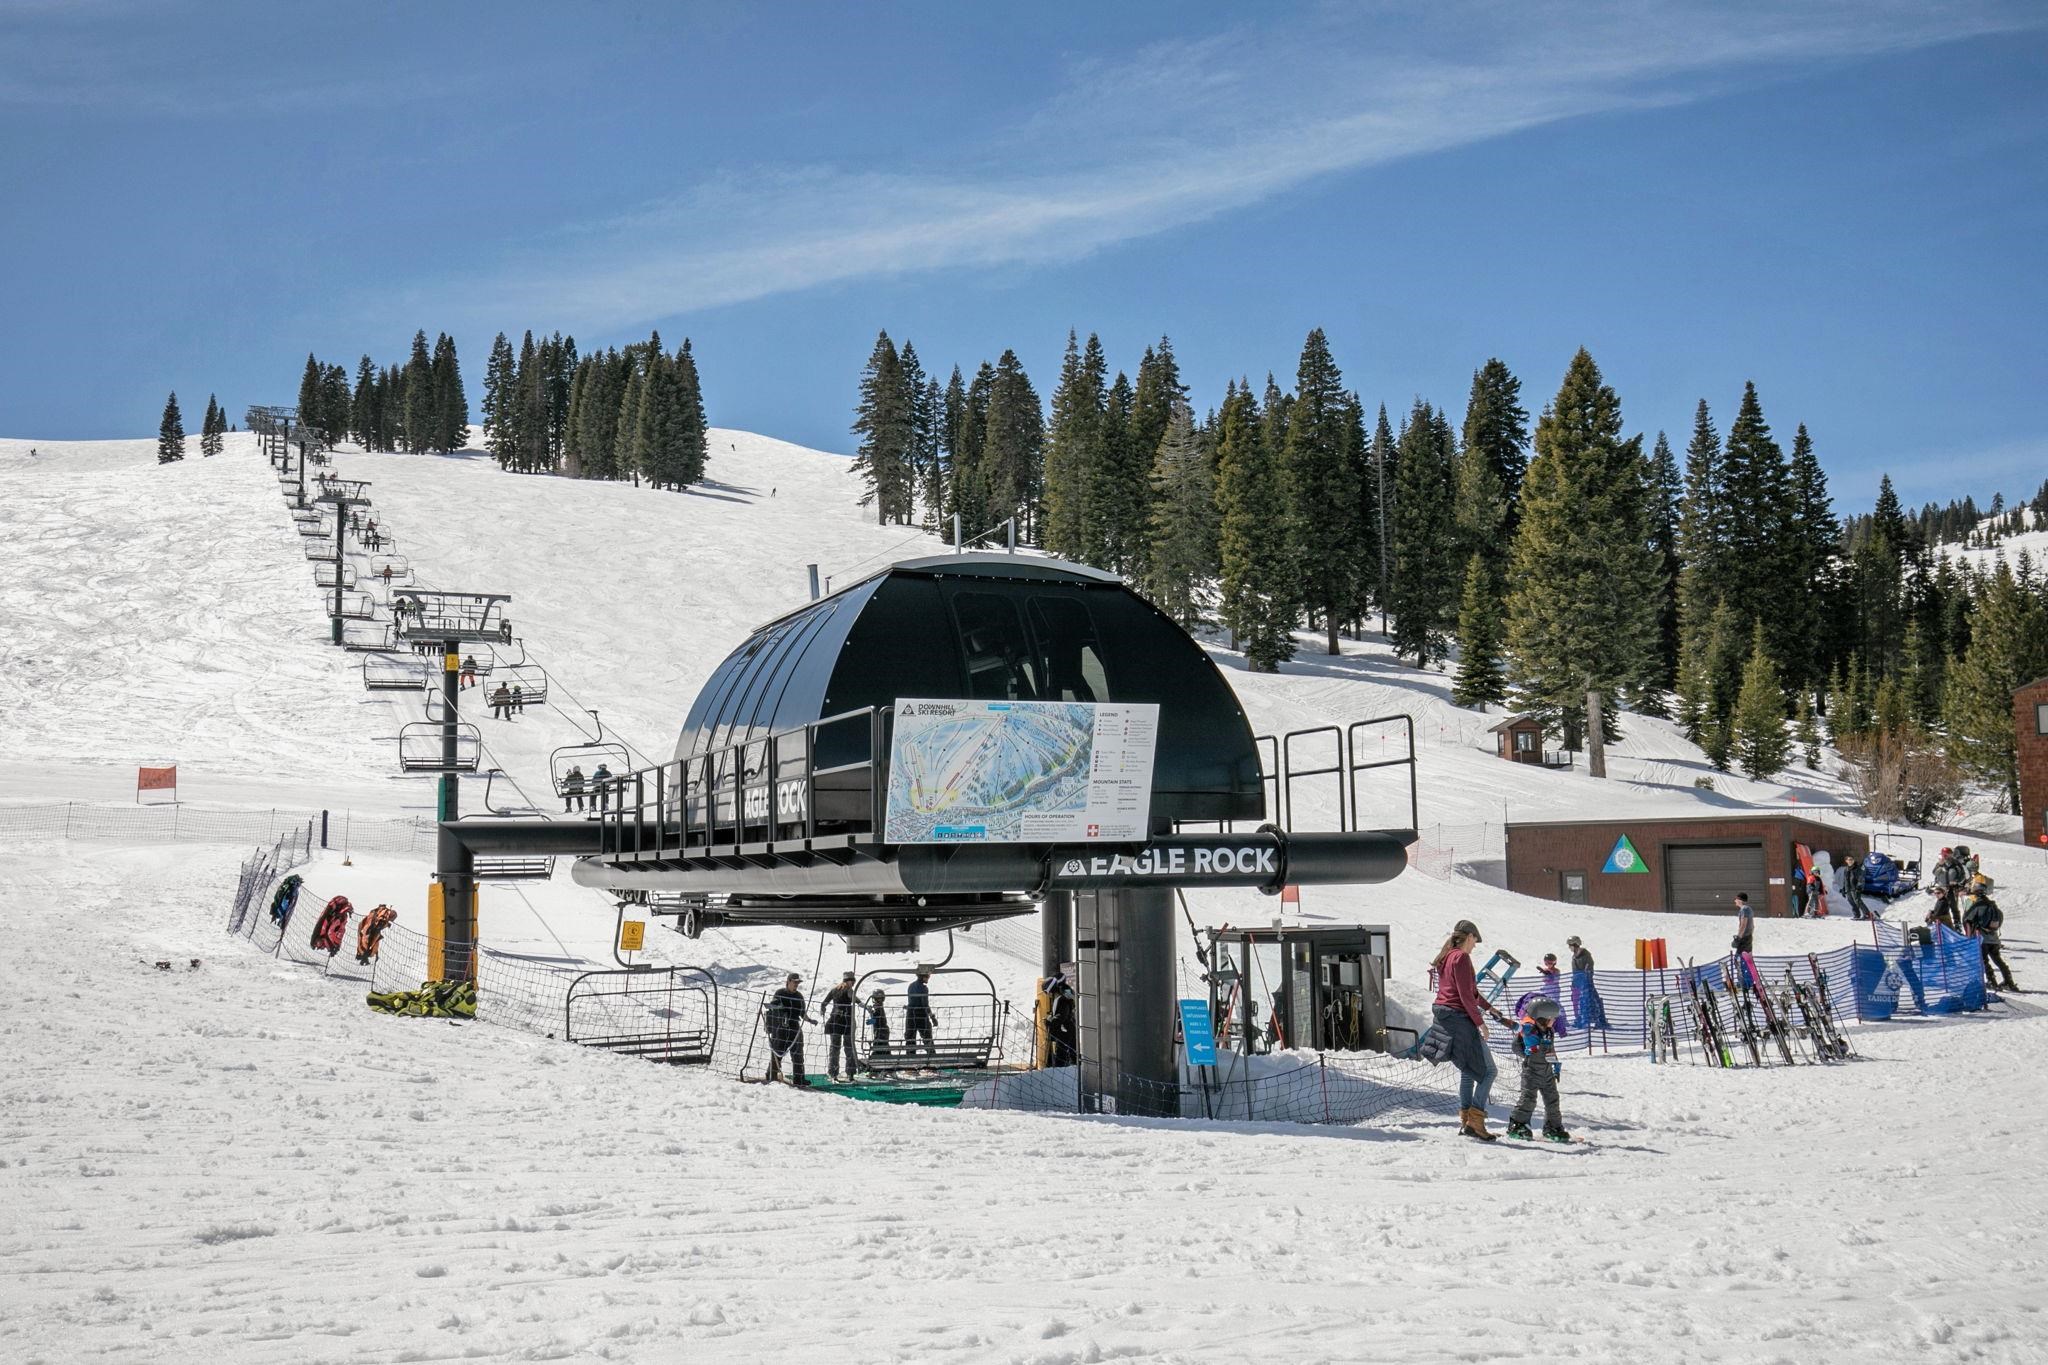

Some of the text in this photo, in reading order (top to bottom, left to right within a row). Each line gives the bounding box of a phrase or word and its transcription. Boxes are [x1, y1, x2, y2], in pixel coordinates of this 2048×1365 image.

[930, 709, 955, 717] RESORT
[777, 780, 807, 815] OCK
[1090, 847, 1275, 876] EAGLE ROCK
